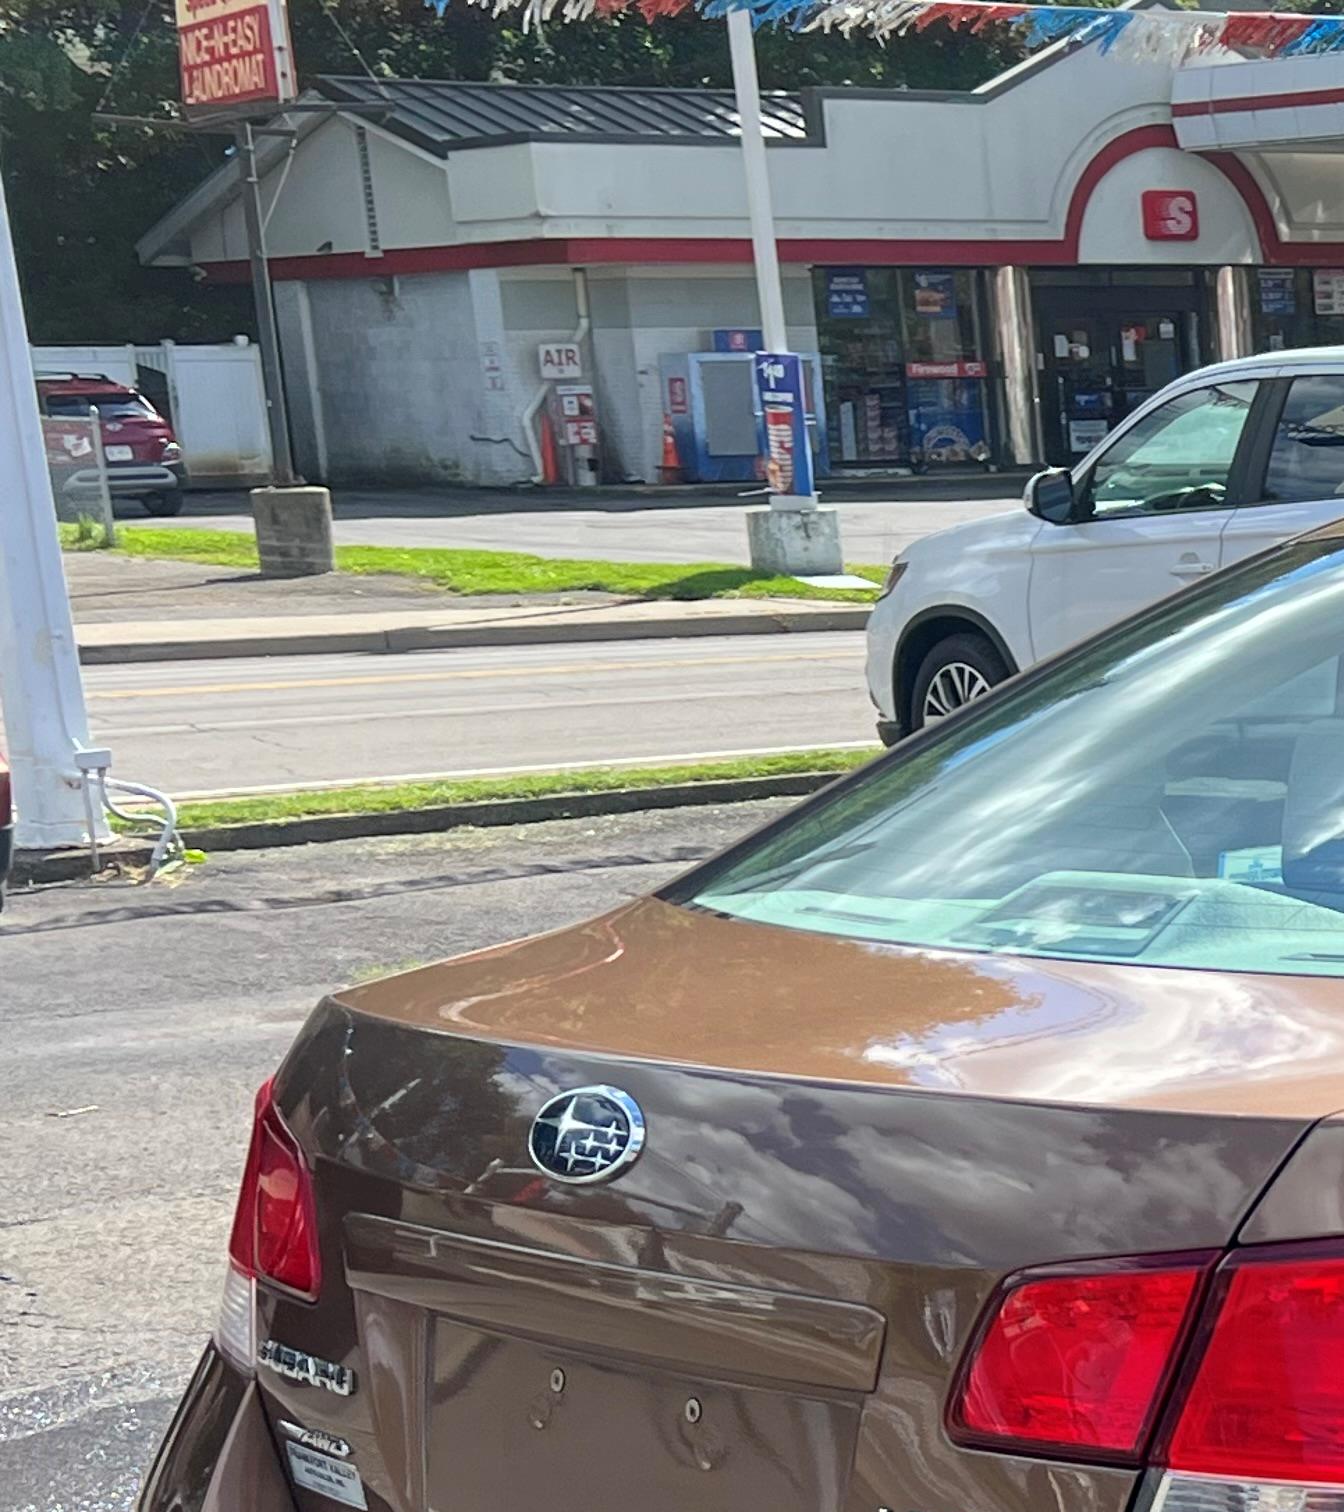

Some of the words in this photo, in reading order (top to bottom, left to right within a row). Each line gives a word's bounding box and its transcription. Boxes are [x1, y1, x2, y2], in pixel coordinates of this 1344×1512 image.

[184, 53, 266, 104] LAUNDROMAT
[543, 348, 579, 367] AIR
[257, 1339, 356, 1396] SUBARU
